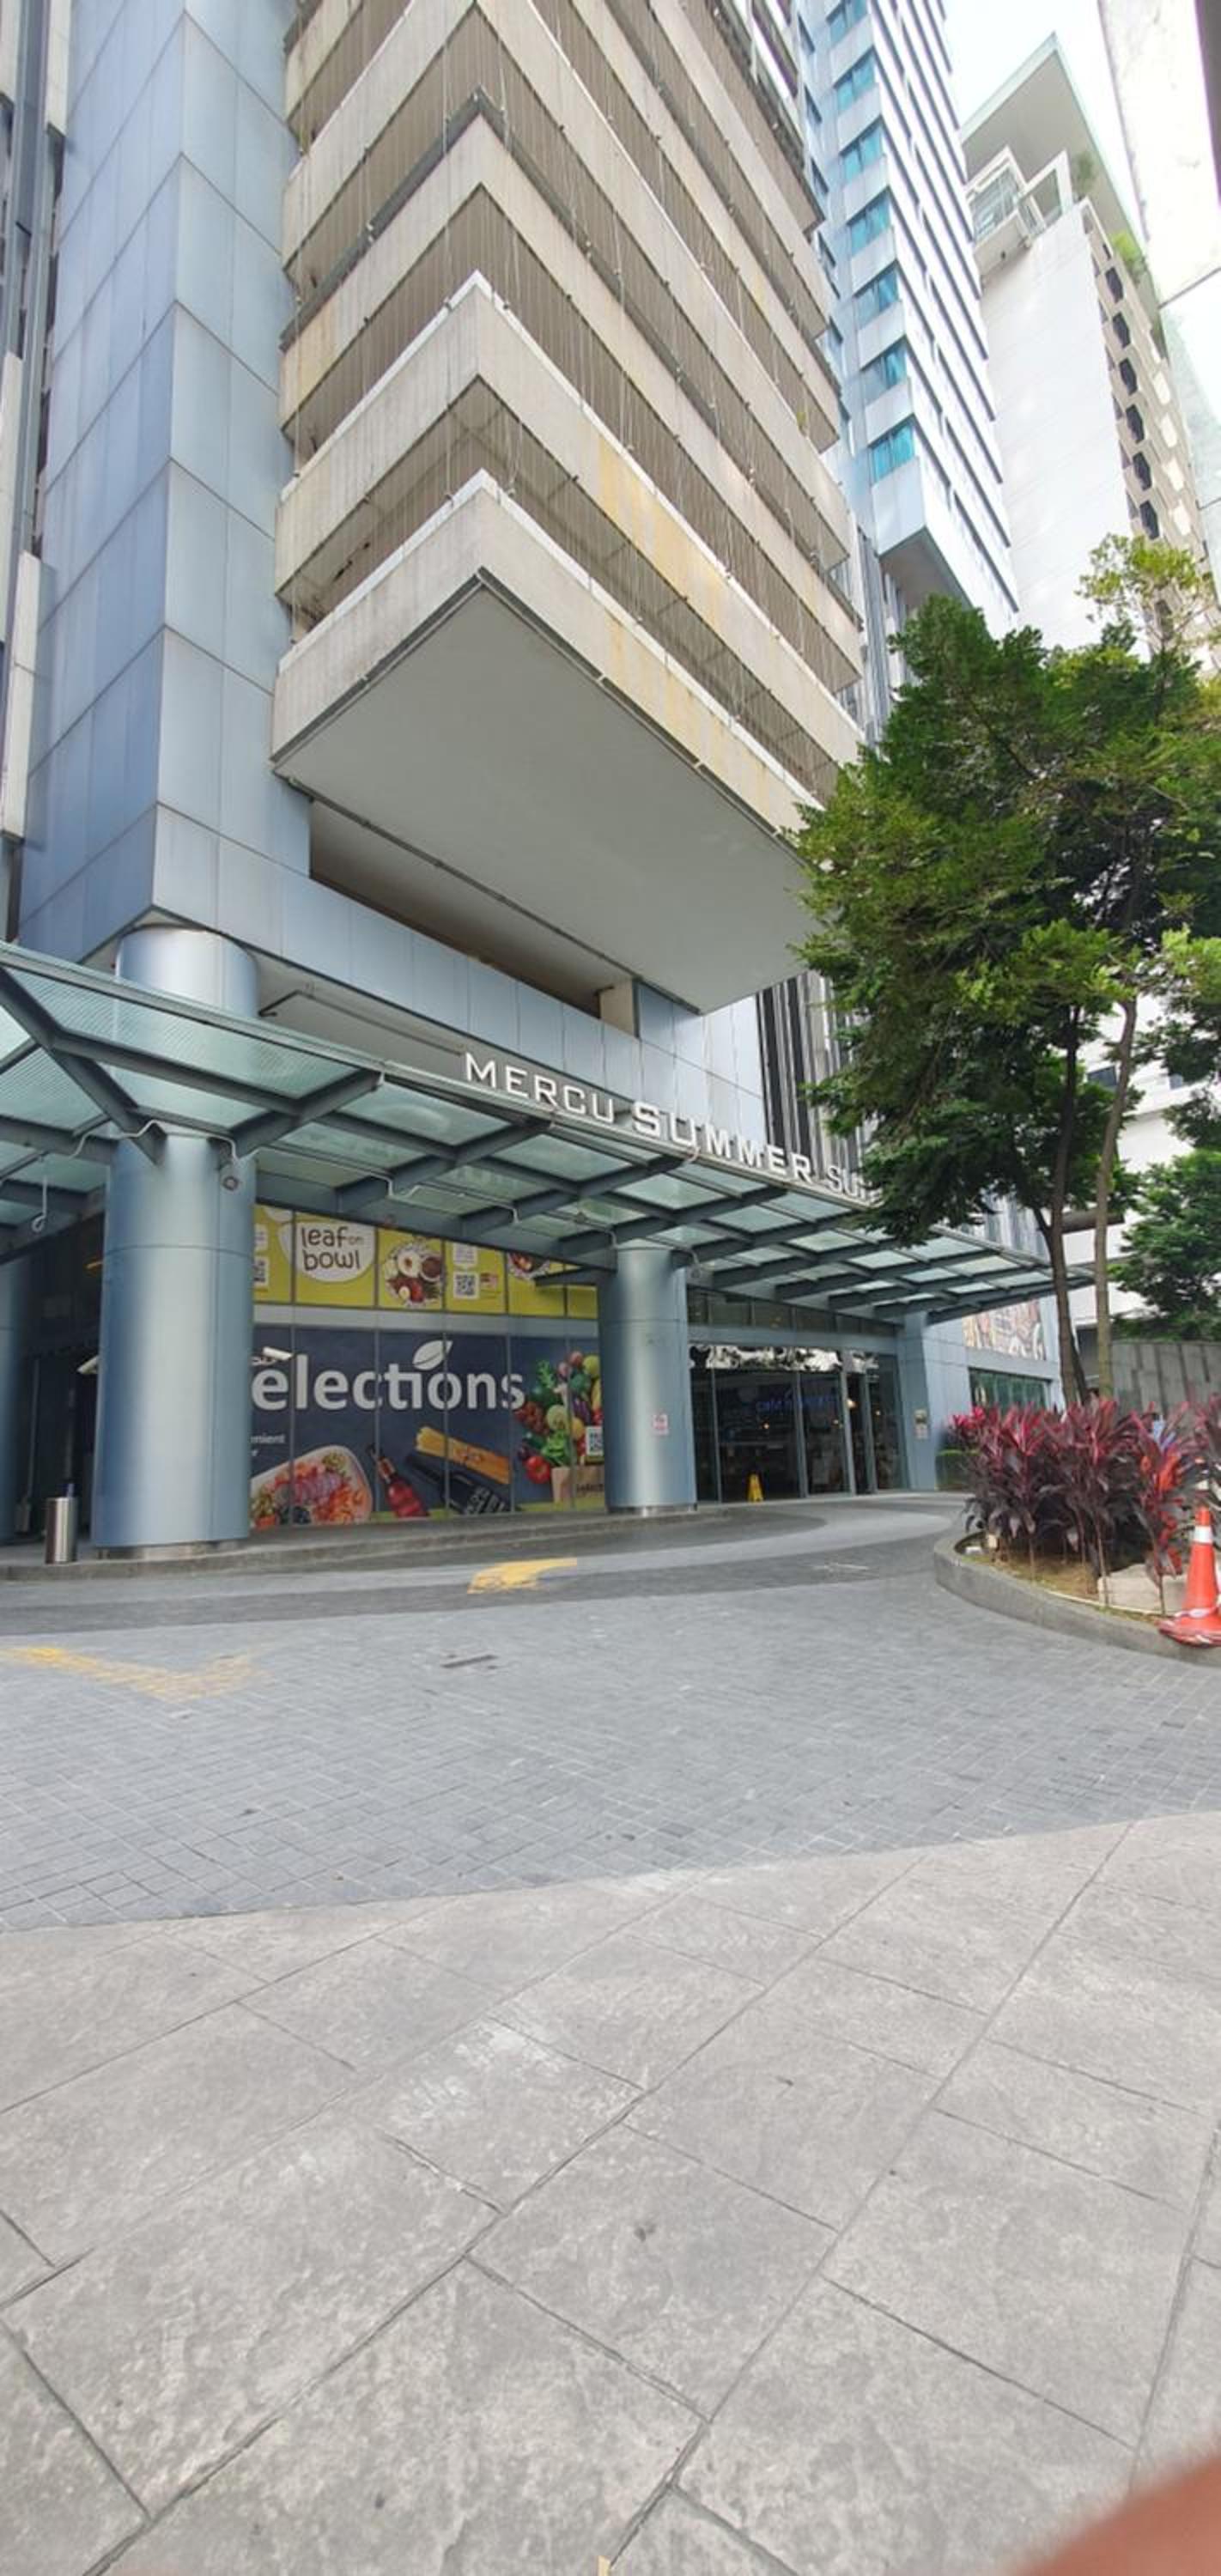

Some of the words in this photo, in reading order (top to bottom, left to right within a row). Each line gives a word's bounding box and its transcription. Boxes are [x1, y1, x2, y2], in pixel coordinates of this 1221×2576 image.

[465, 1053, 614, 1124] MERCU
[631, 1101, 811, 1183] SUMMER
[301, 1226, 348, 1248] leaf
[302, 1249, 361, 1272] bowl
[252, 1353, 525, 1411] elections
